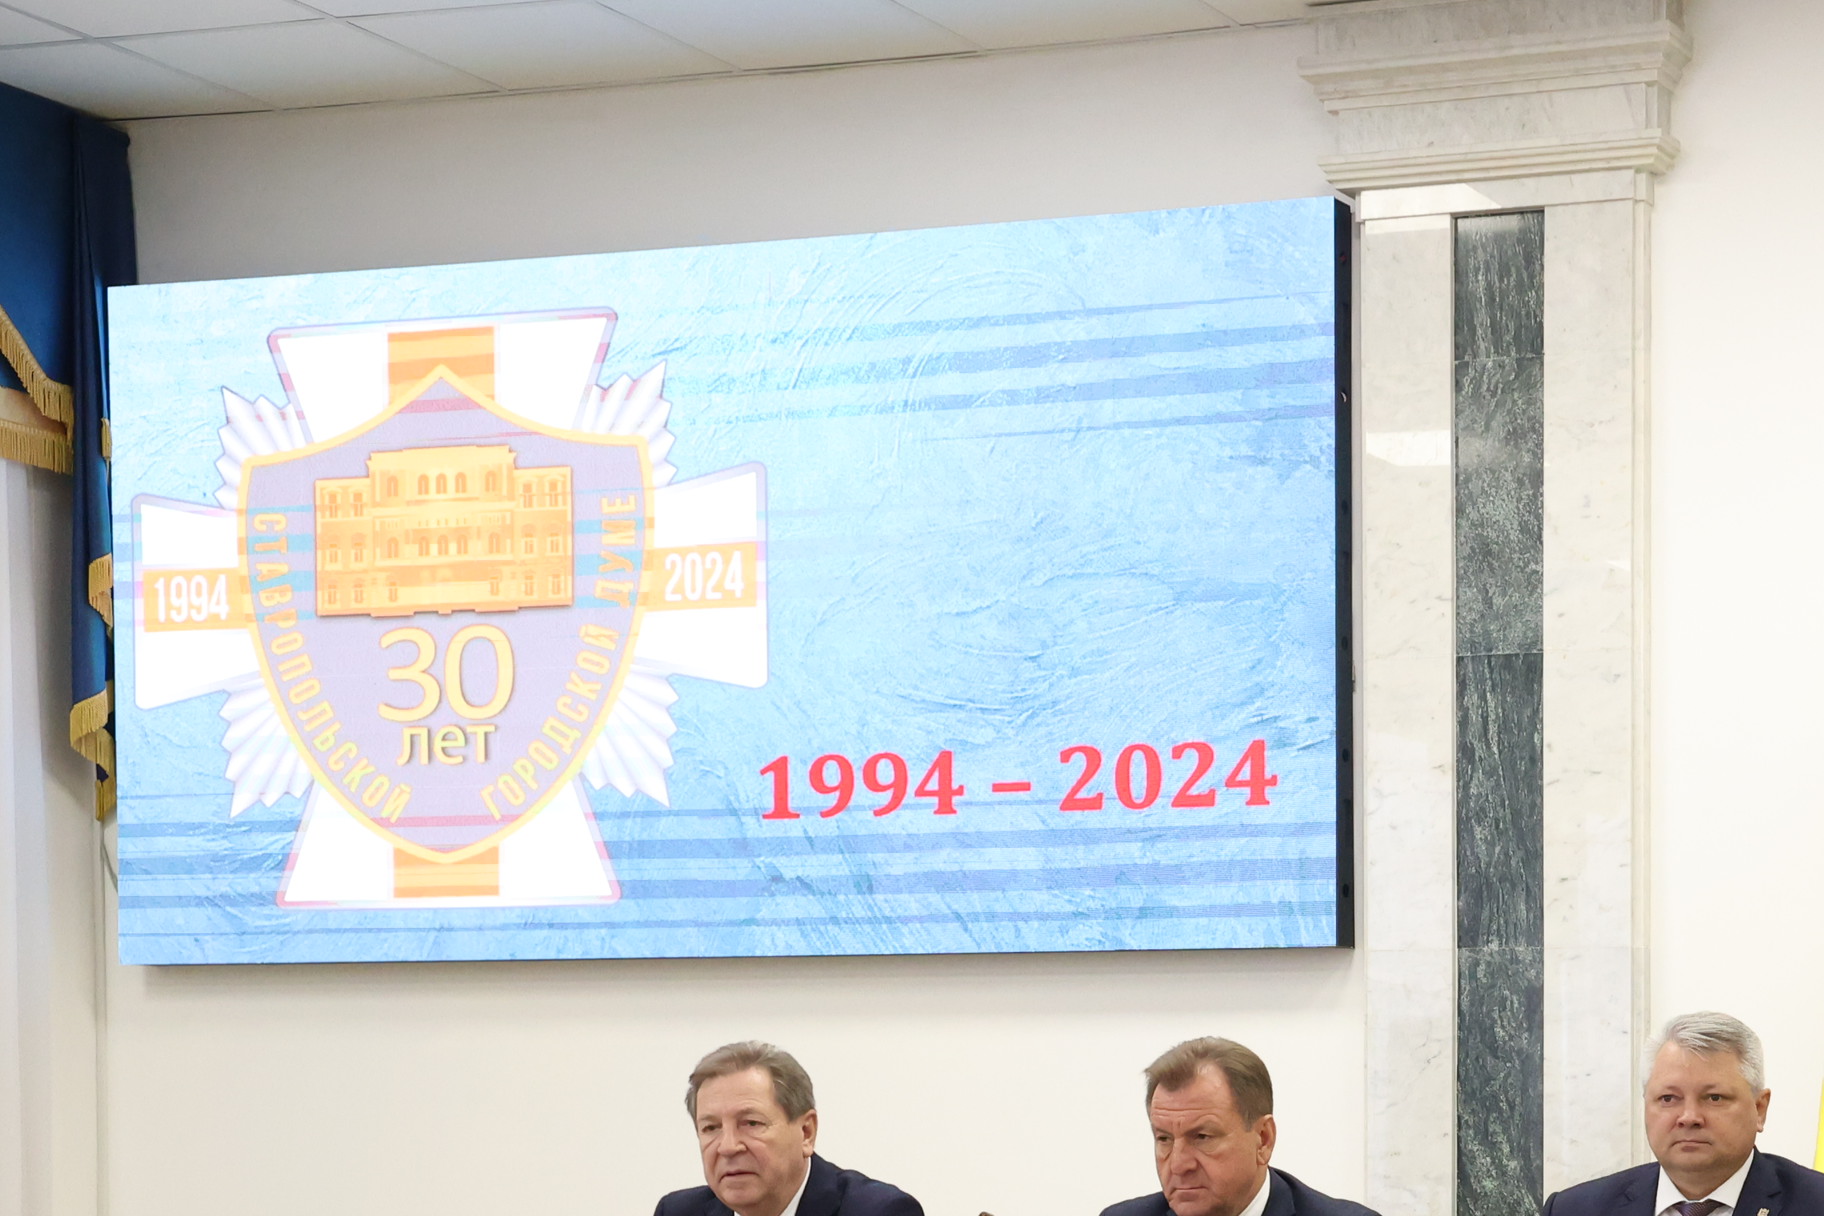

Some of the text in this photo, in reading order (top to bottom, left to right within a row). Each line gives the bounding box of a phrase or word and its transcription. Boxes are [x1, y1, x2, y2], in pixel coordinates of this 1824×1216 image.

[154, 574, 230, 623] 1994
[664, 551, 744, 600] 2024
[252, 493, 636, 824] СТАВРОПОЛЬСКОЙ ГОРОДСКОЙ ДУМЕ
[377, 623, 515, 722] 30
[396, 722, 497, 766] лет
[760, 750, 965, 820] 1994
[1058, 738, 1278, 812] 2024
